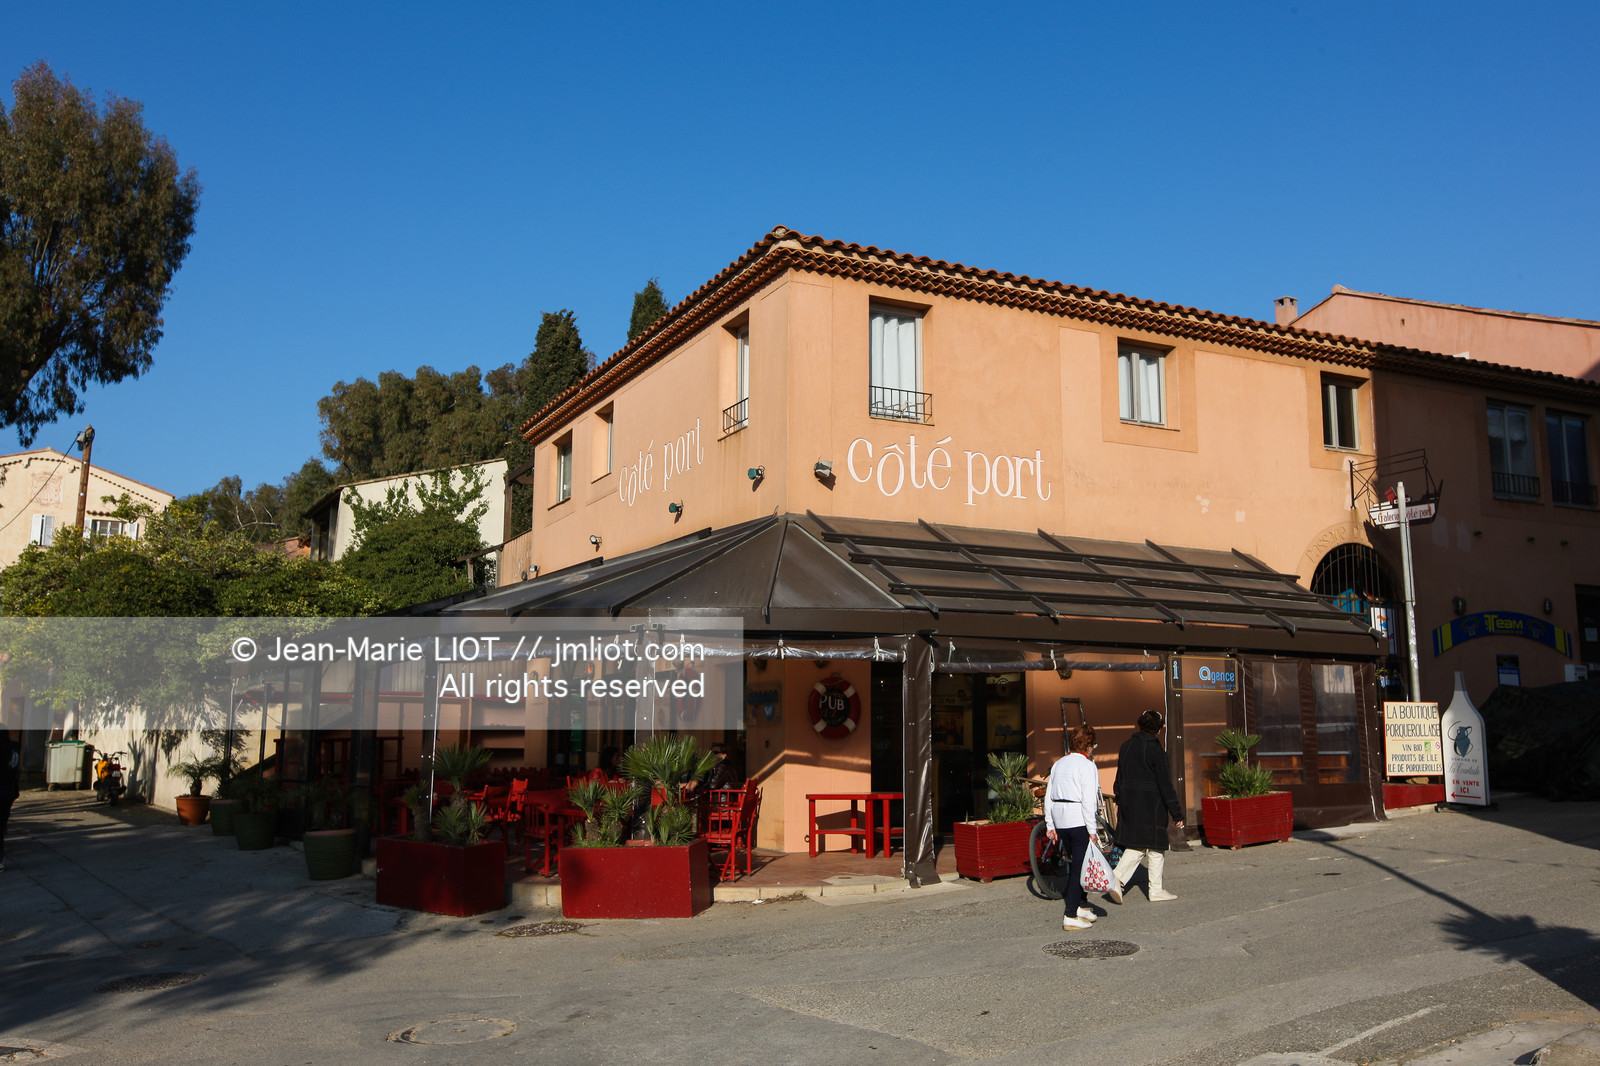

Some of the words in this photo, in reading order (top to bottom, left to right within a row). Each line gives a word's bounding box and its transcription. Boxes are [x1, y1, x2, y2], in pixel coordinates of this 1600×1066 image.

[663, 417, 704, 493] port
[964, 449, 1051, 506] port
[818, 694, 845, 711] PUB
[1386, 705, 1398, 719] LA
[1400, 705, 1438, 720] BOUTIQUE
[1385, 724, 1440, 739] PORQUEROLLAISE
[1402, 744, 1412, 752] VIN
[1413, 744, 1423, 752] BIO
[1392, 754, 1417, 762] PRODUITS
[1418, 754, 1425, 762] DE
[1387, 764, 1396, 772] ILE
[1397, 764, 1404, 772] DE
[1405, 764, 1443, 773] PORQUEROLLES
